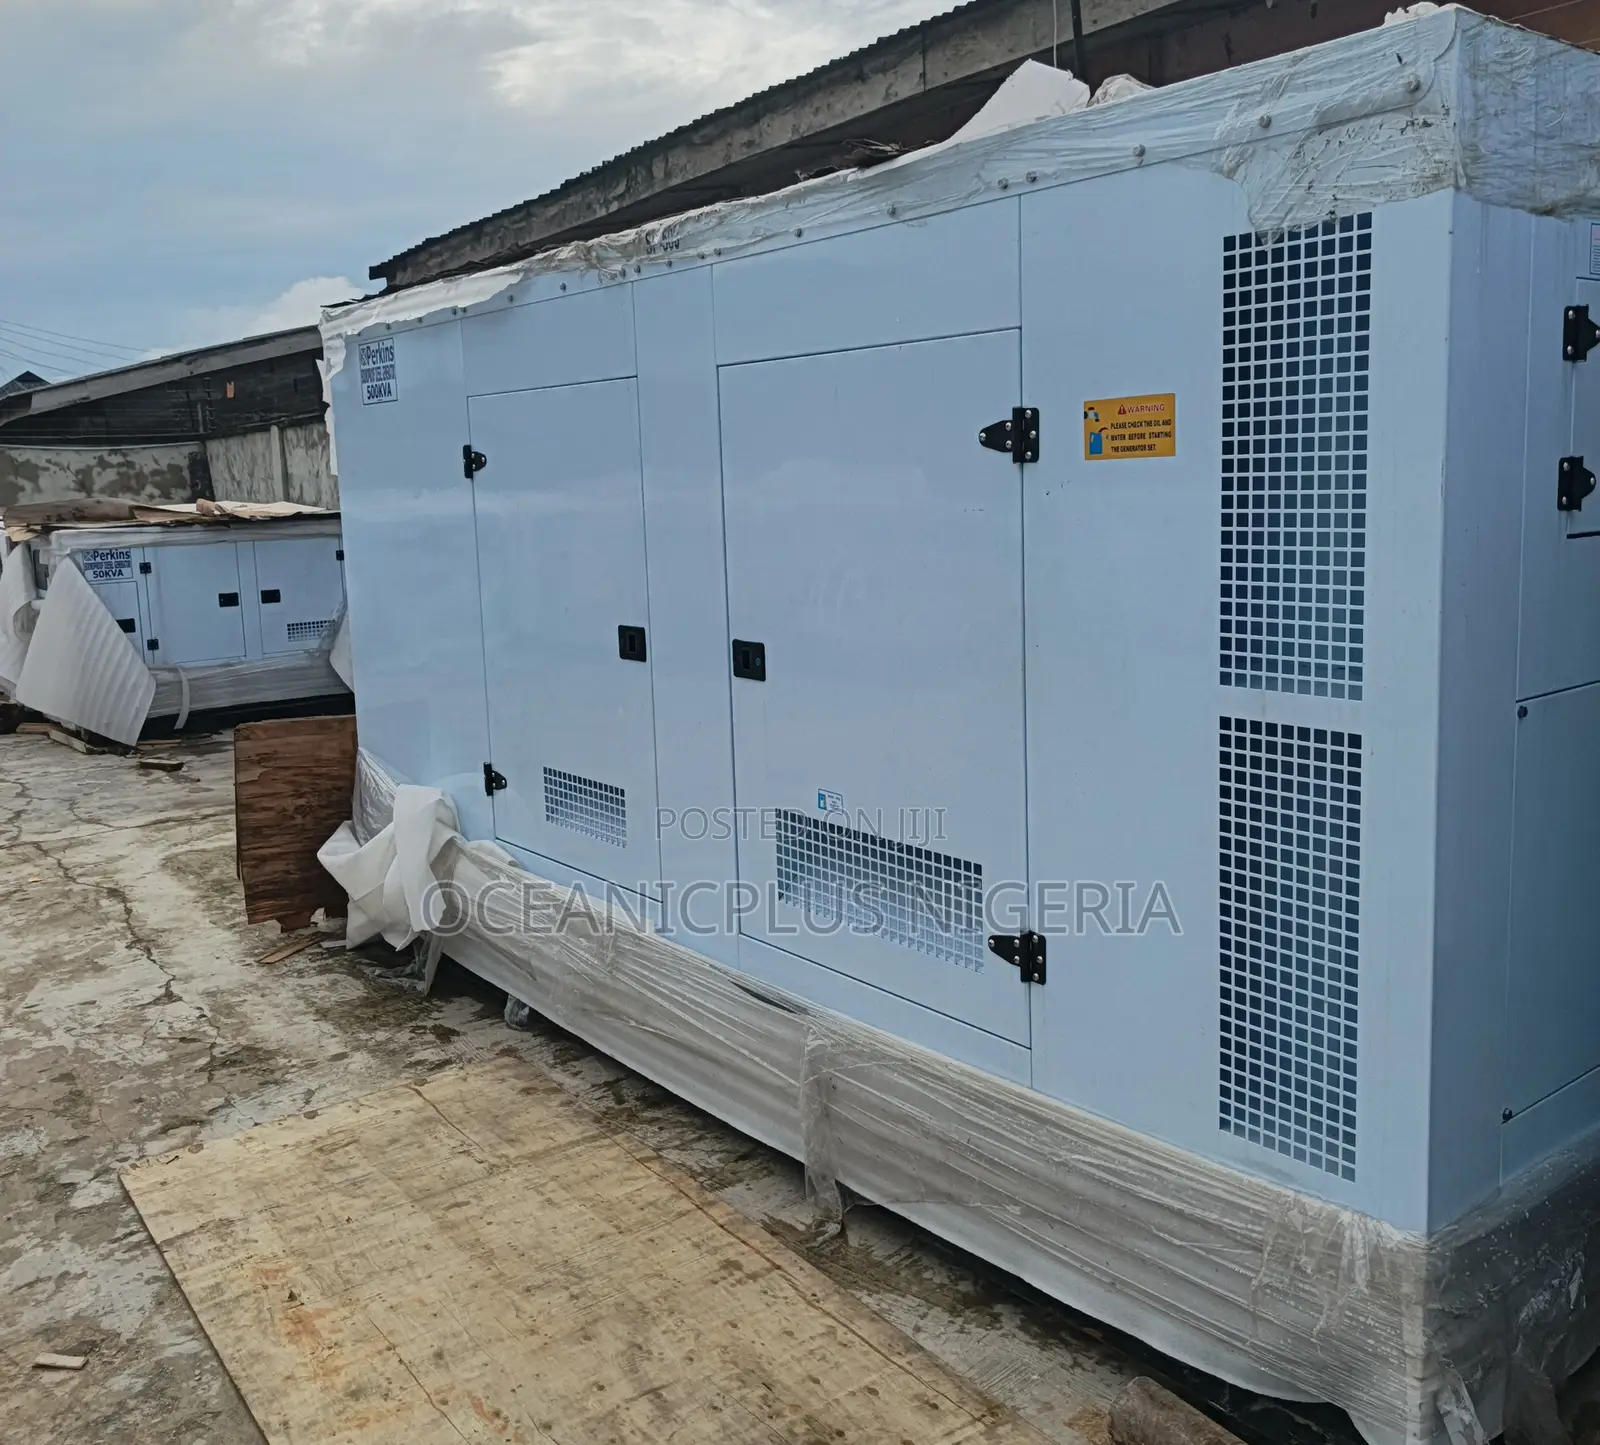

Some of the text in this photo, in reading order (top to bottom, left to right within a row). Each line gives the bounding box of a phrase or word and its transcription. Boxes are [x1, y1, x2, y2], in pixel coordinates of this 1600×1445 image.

[366, 341, 394, 366] Perkins
[366, 382, 392, 400] 500KVA
[1128, 404, 1165, 413] WARNING
[1111, 422, 1127, 430] PLEASE
[1128, 421, 1143, 429] CHECK
[1153, 419, 1161, 427] OIL
[1128, 432, 1146, 440] BEFORE
[1148, 431, 1172, 439] STARTING
[92, 549, 131, 561] Perkins
[93, 569, 124, 578] 50KVA
